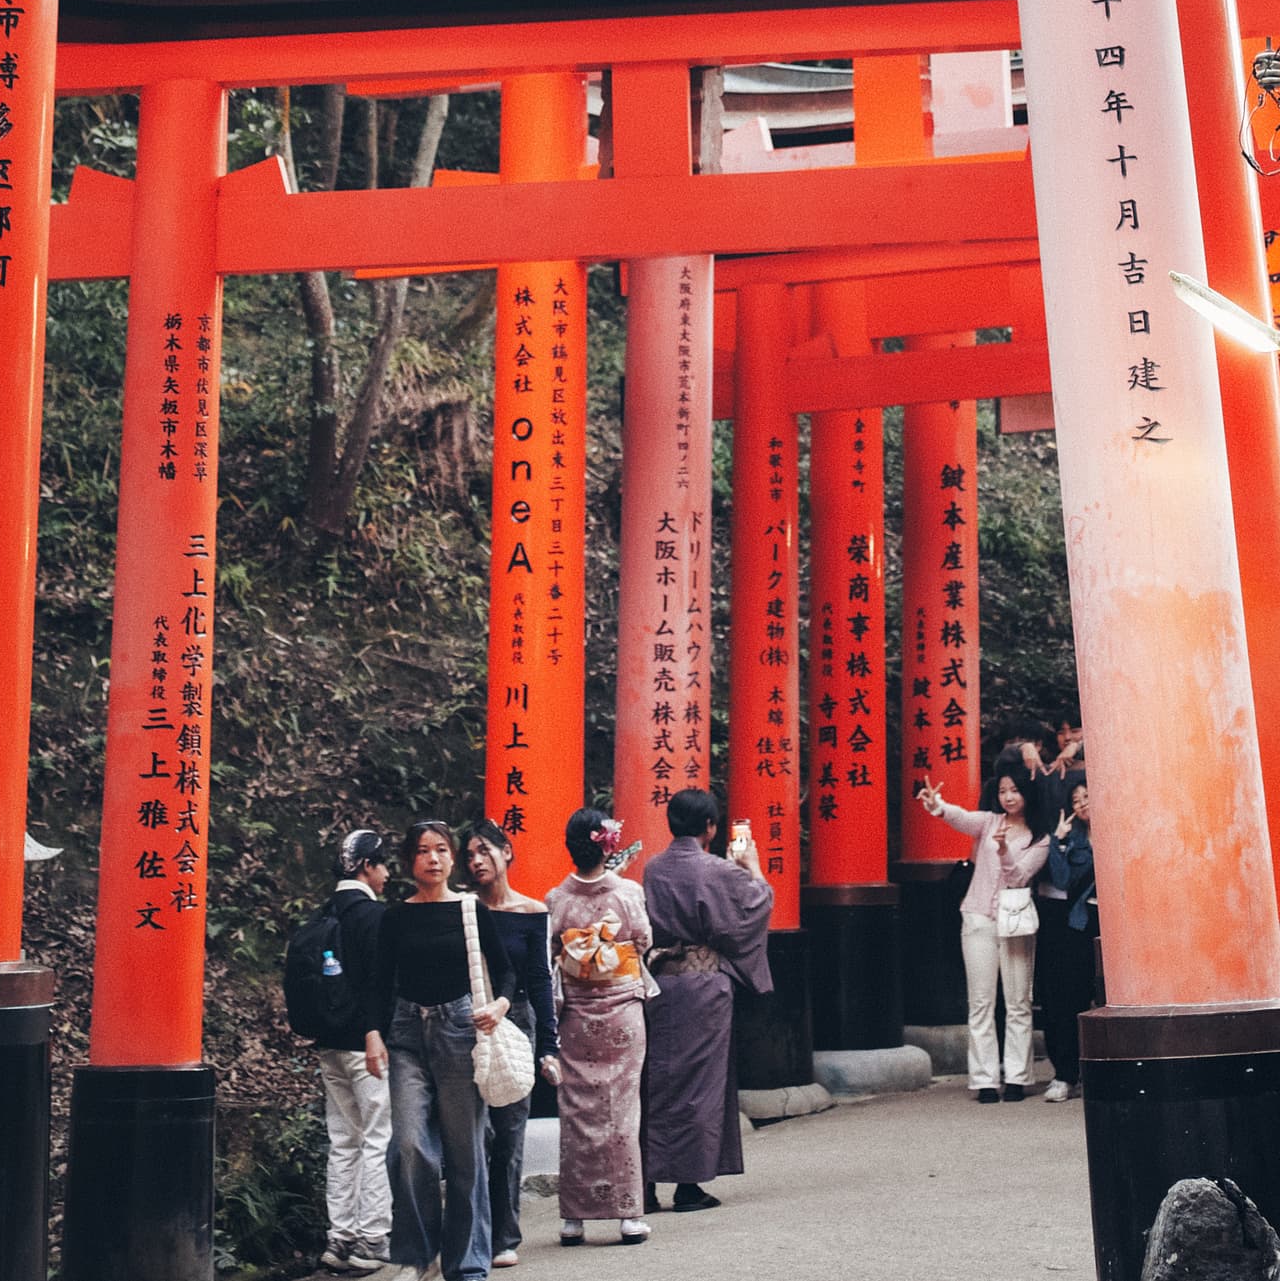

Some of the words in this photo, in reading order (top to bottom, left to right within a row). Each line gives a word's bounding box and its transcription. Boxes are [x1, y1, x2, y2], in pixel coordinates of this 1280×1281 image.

[650, 511, 679, 807] 大阪ホーム販売株式会社
[683, 510, 704, 791] ドリームハウス株式会
